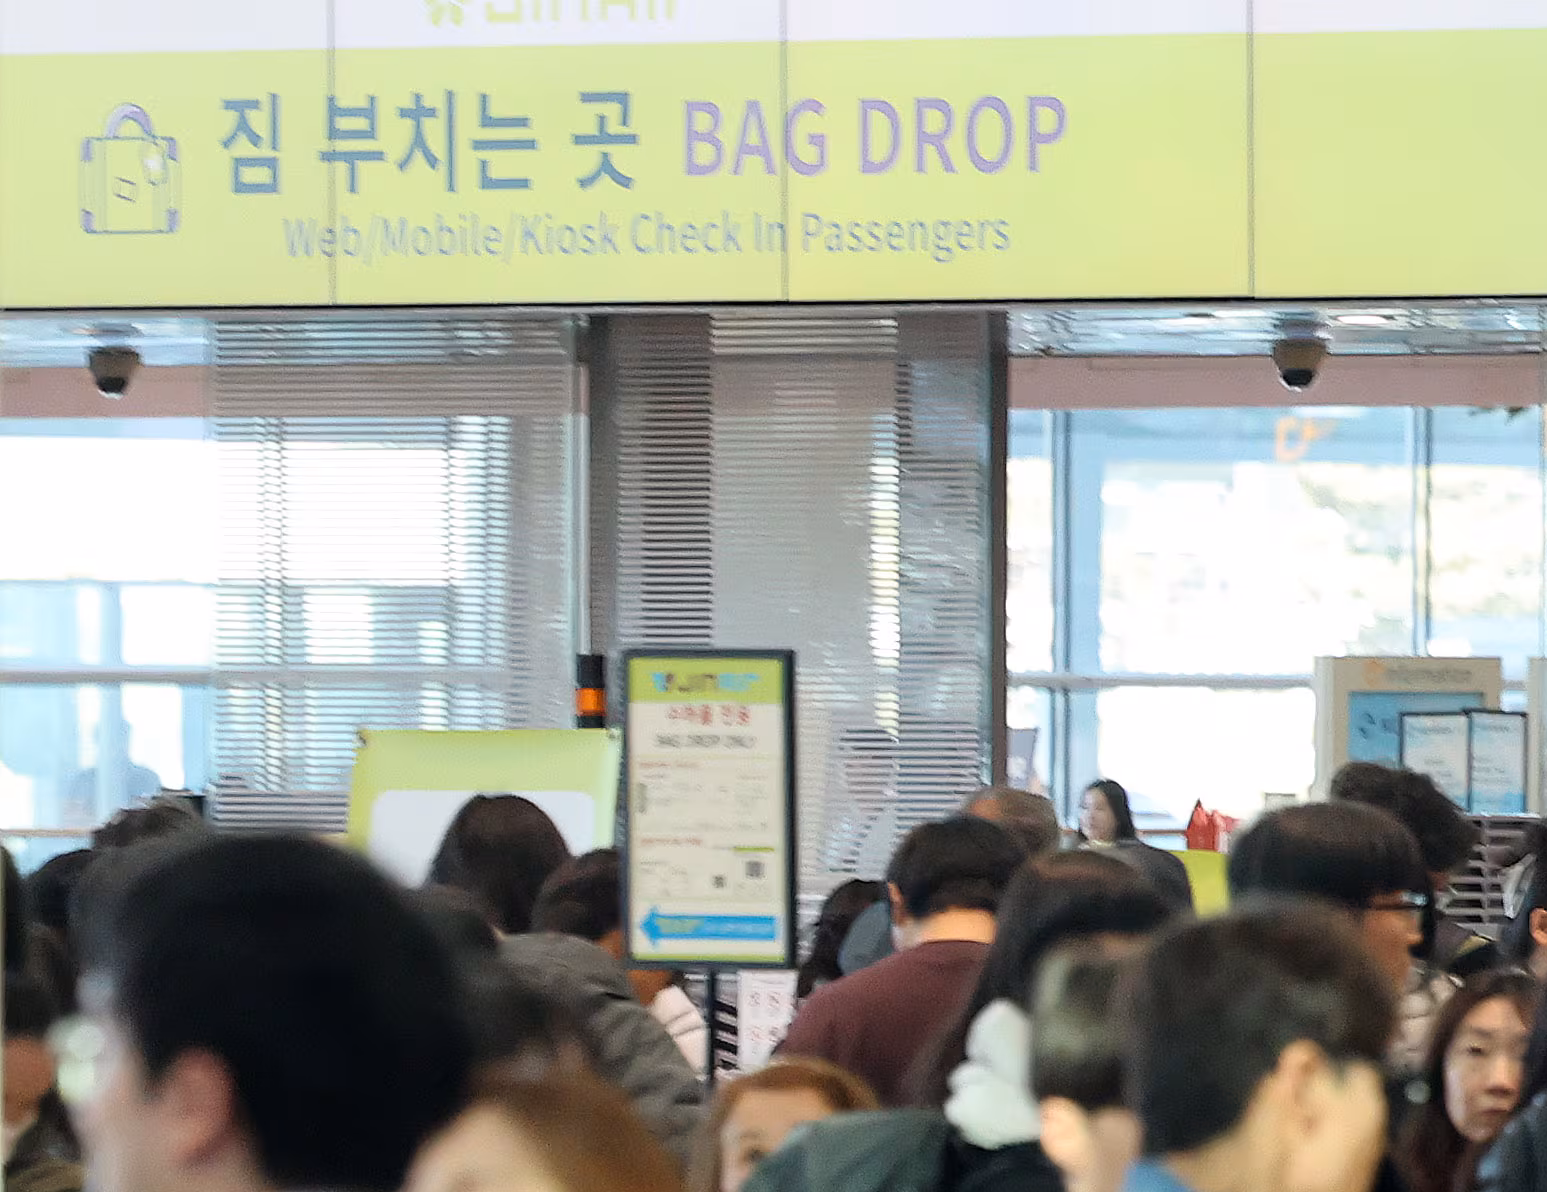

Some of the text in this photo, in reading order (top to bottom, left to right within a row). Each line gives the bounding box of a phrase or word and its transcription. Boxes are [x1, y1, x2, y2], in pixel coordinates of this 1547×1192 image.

[220, 90, 639, 194] 짐 부치는 곳
[684, 95, 1068, 176] BAG DROP
[284, 211, 1010, 264] Web/Mobile/Kiosk Check In Passengers
